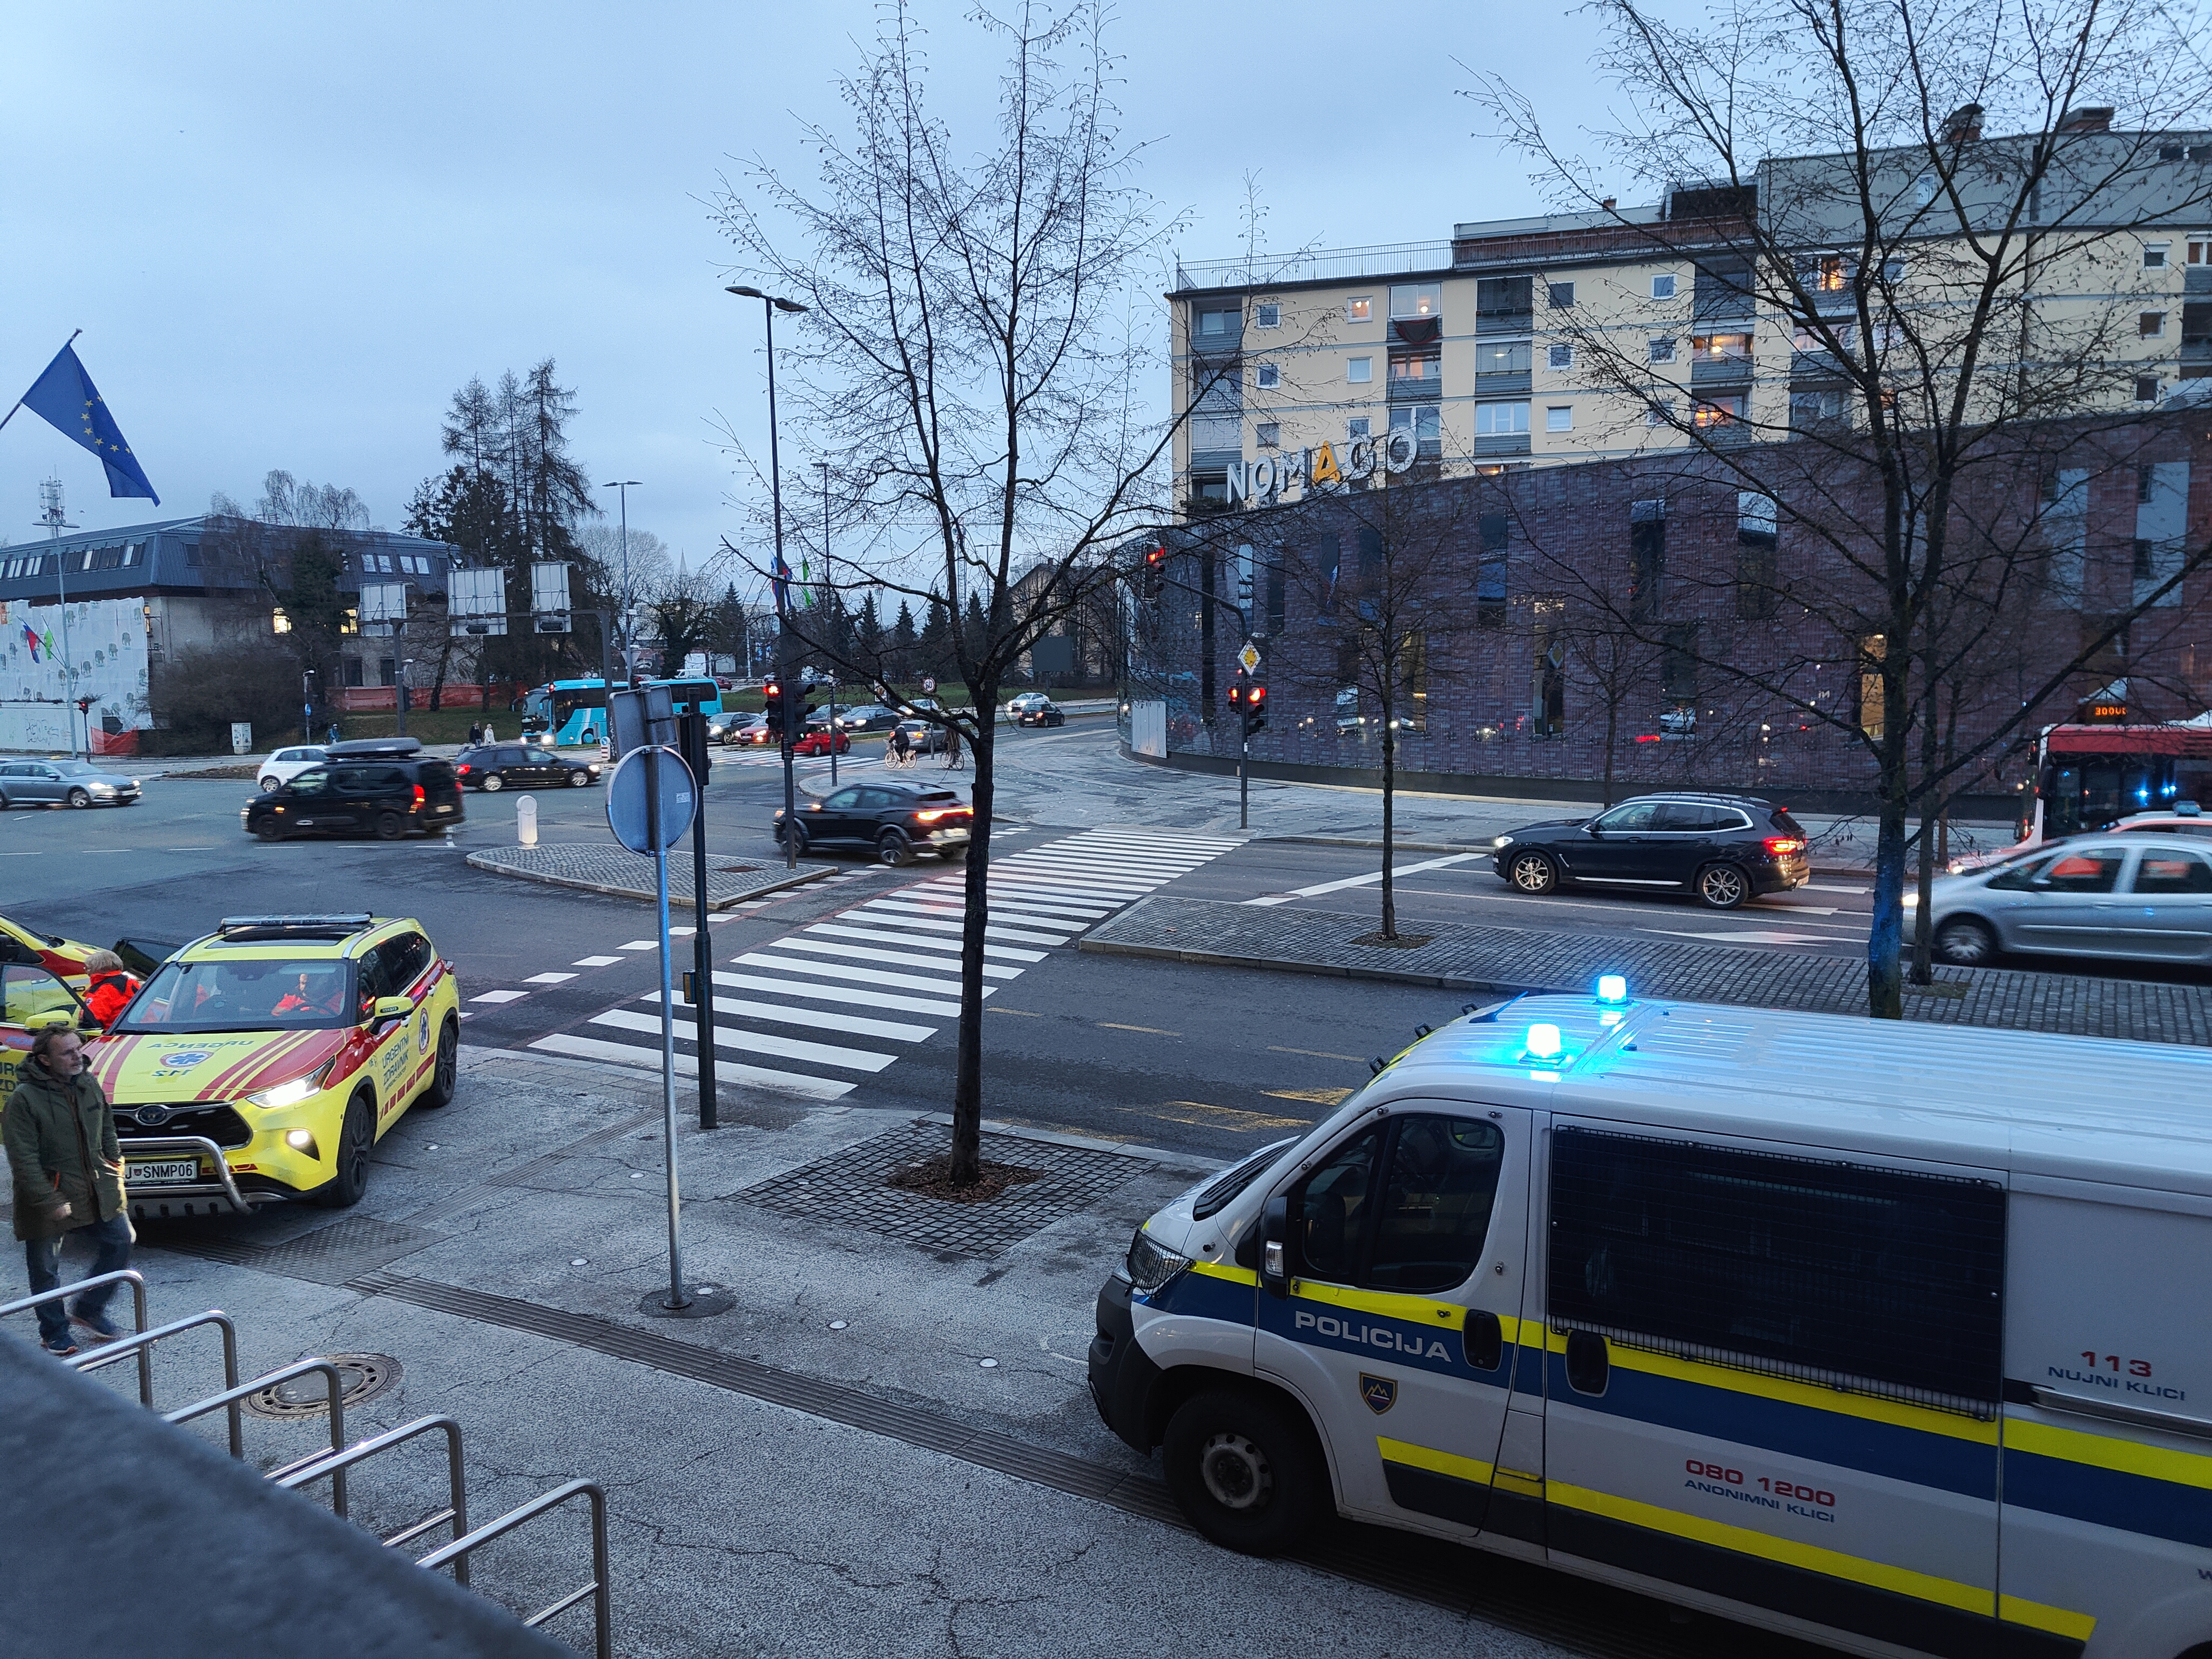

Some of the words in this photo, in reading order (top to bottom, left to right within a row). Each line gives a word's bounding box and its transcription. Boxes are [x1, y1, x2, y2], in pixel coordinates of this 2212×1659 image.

[1227, 426, 1420, 503] NOMAGO
[143, 1164, 192, 1179] SNMP06
[1296, 1311, 1452, 1363] POLICIJA
[2048, 1366, 2119, 1388] NUJNI
[2126, 1381, 2185, 1401] KLICI
[2081, 1351, 2152, 1377] 113
[1684, 1480, 1779, 1510] ANONIMNI
[1786, 1503, 1835, 1522] KLICI
[1686, 1459, 1743, 1485] 080
[1757, 1477, 1835, 1507] 1200
